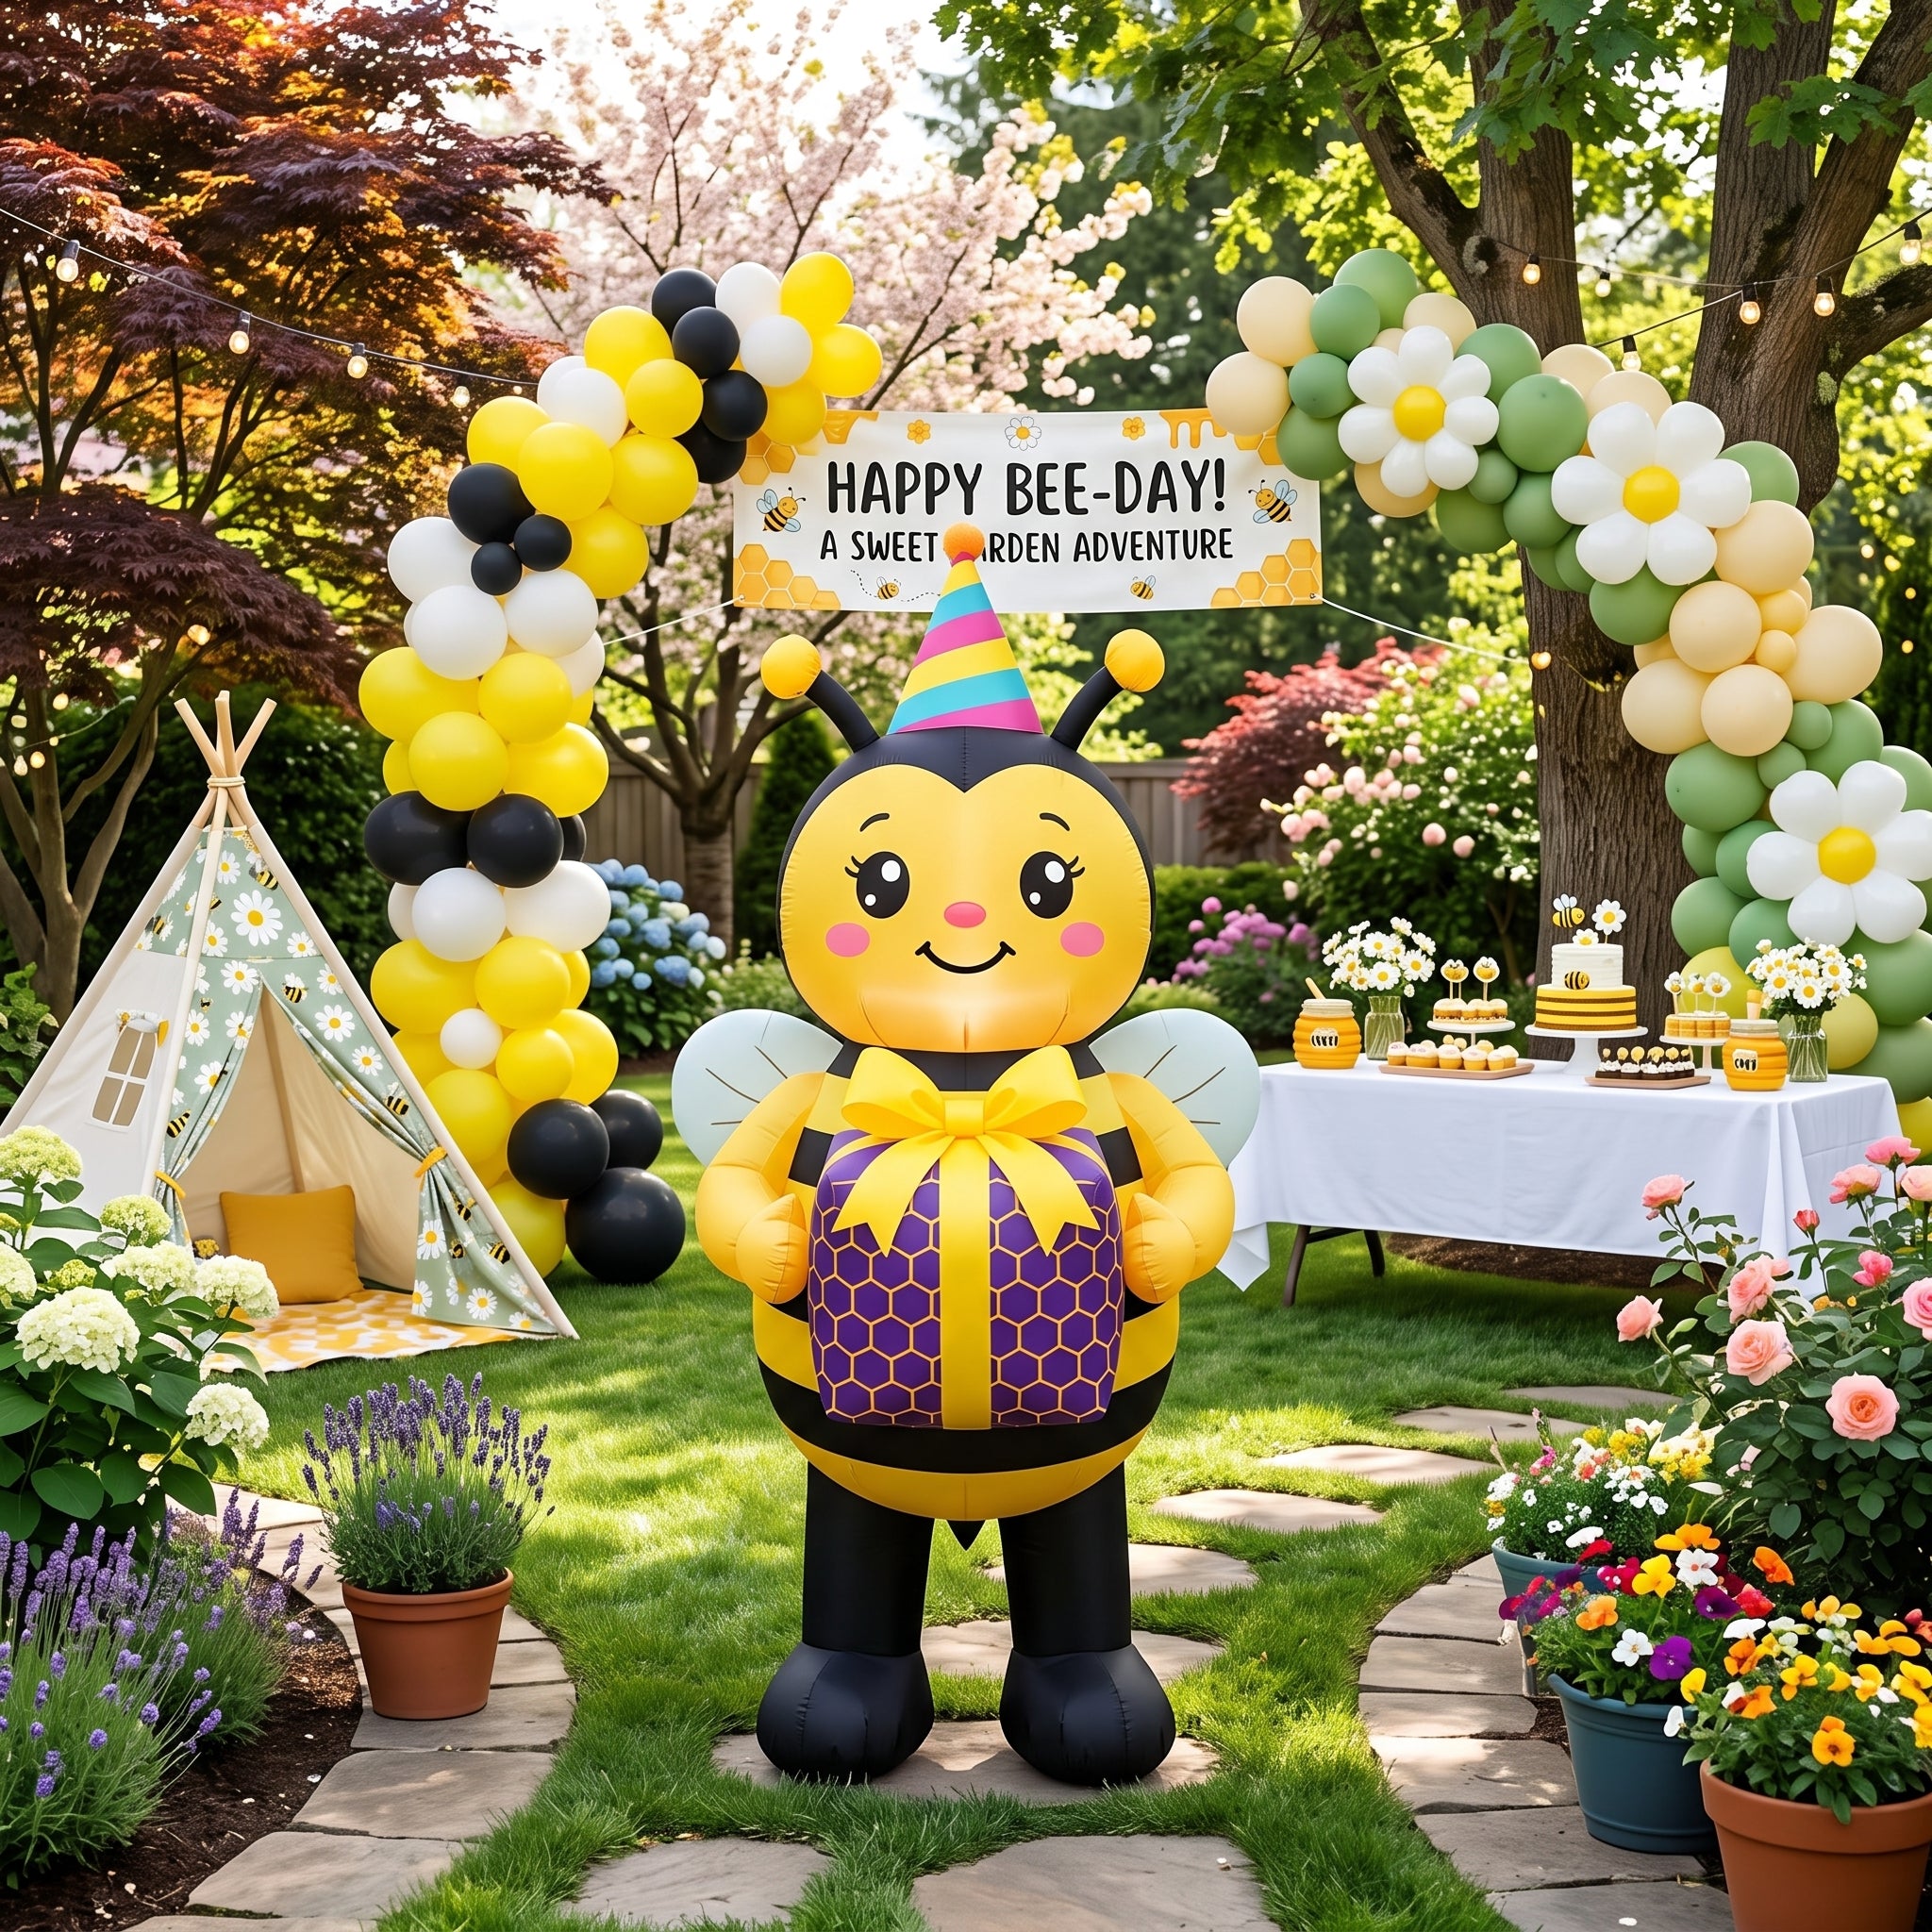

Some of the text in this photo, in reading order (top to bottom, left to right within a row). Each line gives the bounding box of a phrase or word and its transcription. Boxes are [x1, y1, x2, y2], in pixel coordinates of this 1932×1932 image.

[827, 458, 1225, 516] HAPPY BEE-DAY!
[820, 527, 1234, 563] A SWEET RDEN ADVENTURE
